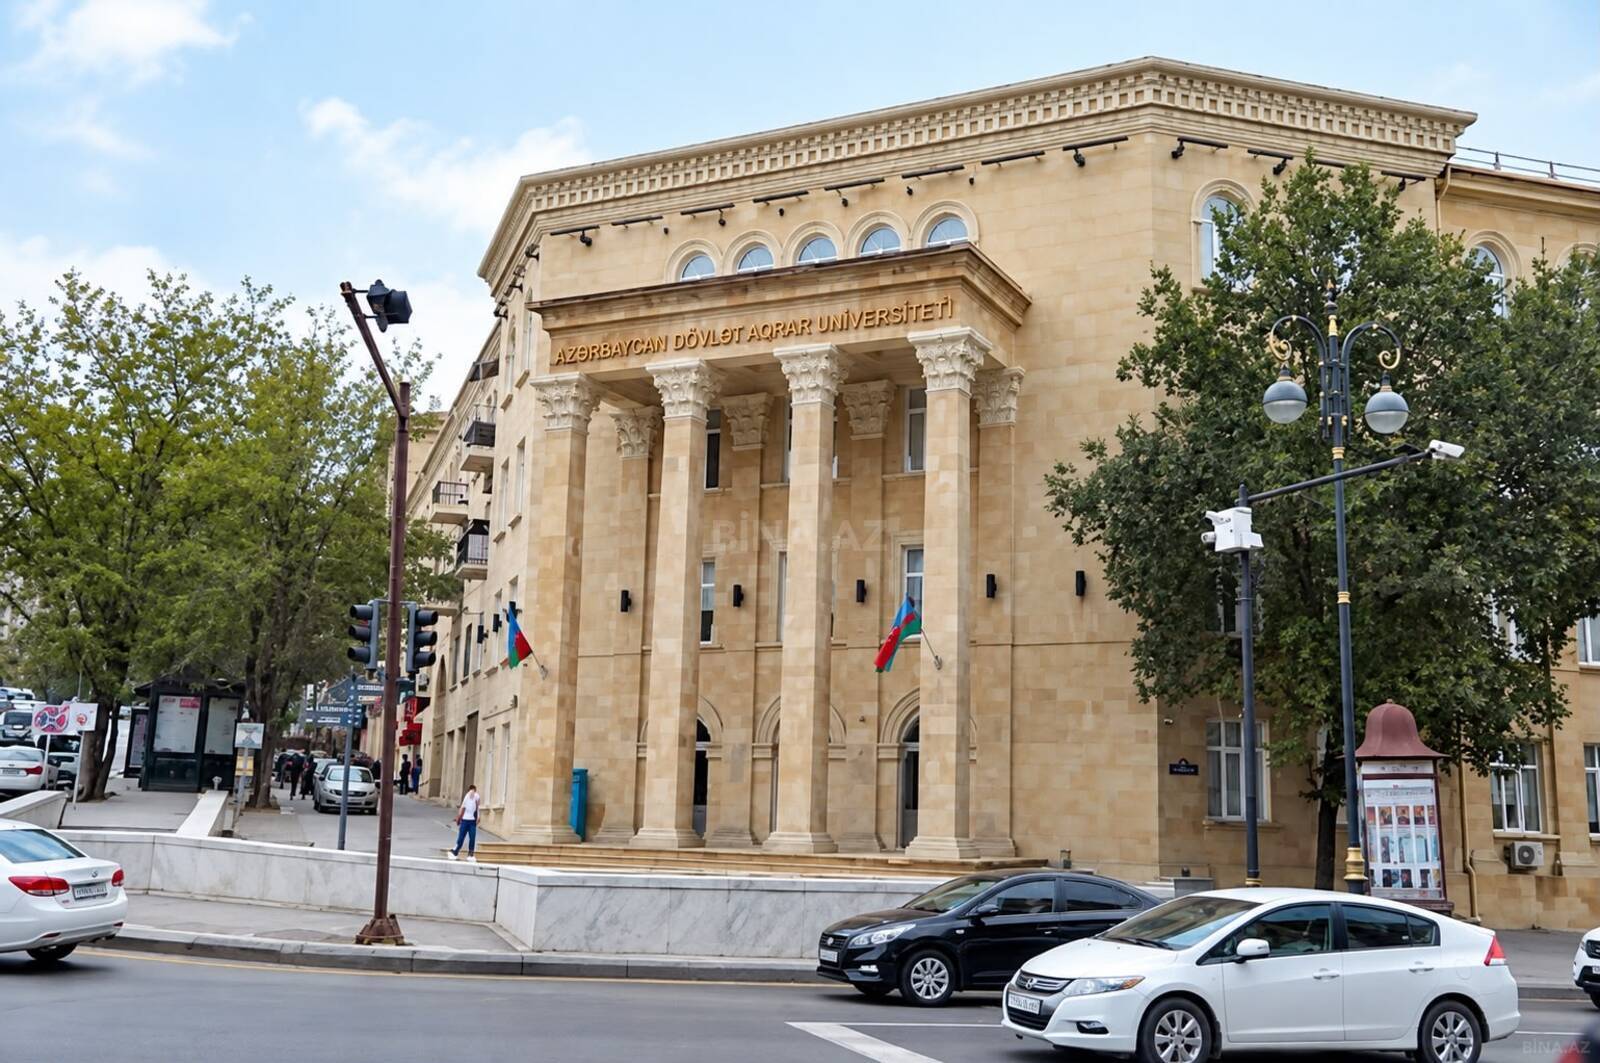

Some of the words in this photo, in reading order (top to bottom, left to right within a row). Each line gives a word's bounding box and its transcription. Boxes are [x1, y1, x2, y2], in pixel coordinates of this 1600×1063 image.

[555, 335, 668, 366] AZƏRBAYCAN
[673, 326, 744, 351] DÖVLƏT
[747, 316, 812, 342] AQRAR
[817, 295, 953, 333] UNİVERSİTETİ
